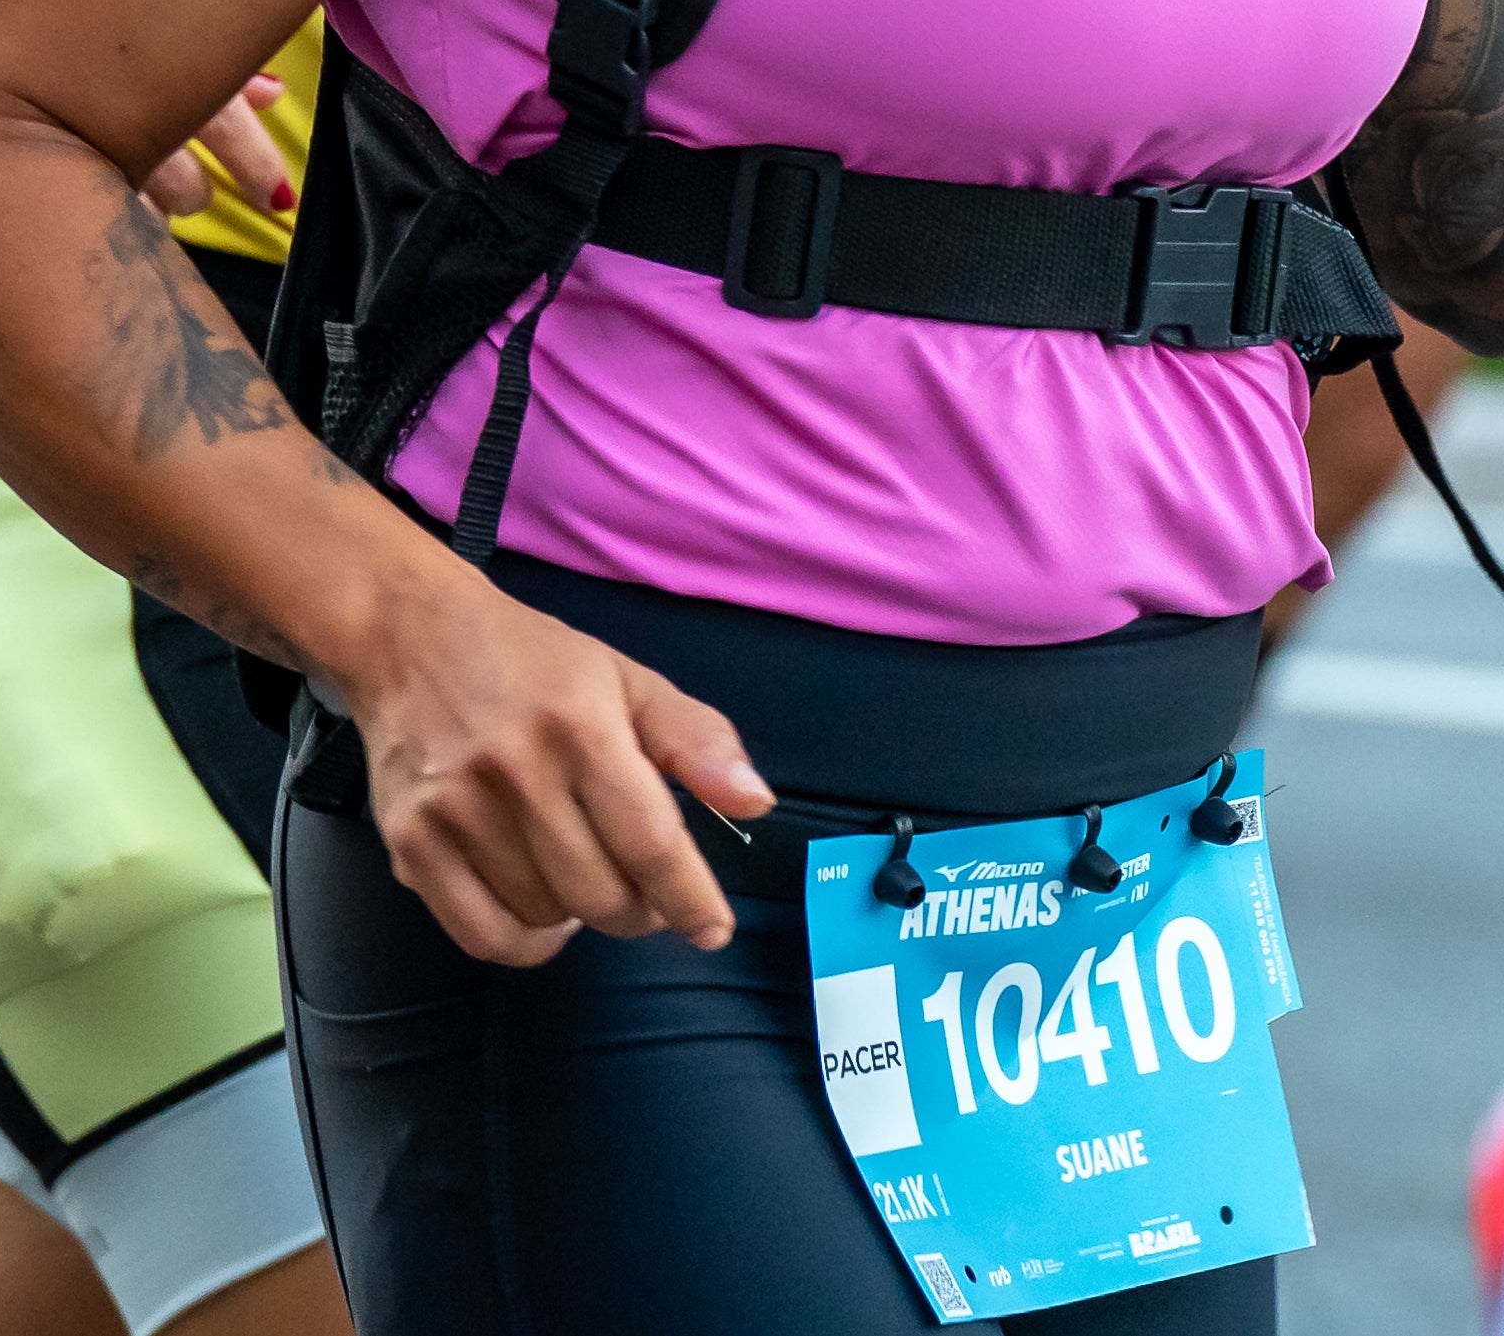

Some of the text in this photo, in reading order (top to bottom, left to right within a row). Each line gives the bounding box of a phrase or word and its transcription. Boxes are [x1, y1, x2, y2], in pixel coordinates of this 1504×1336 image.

[816, 863, 849, 883] 10410
[899, 879, 1064, 941] ATHENAS
[922, 915, 1238, 1115] 10410
[824, 1039, 902, 1083] PACER
[1055, 1128, 1149, 1184] SUANE
[872, 1173, 940, 1224] 21.1K
